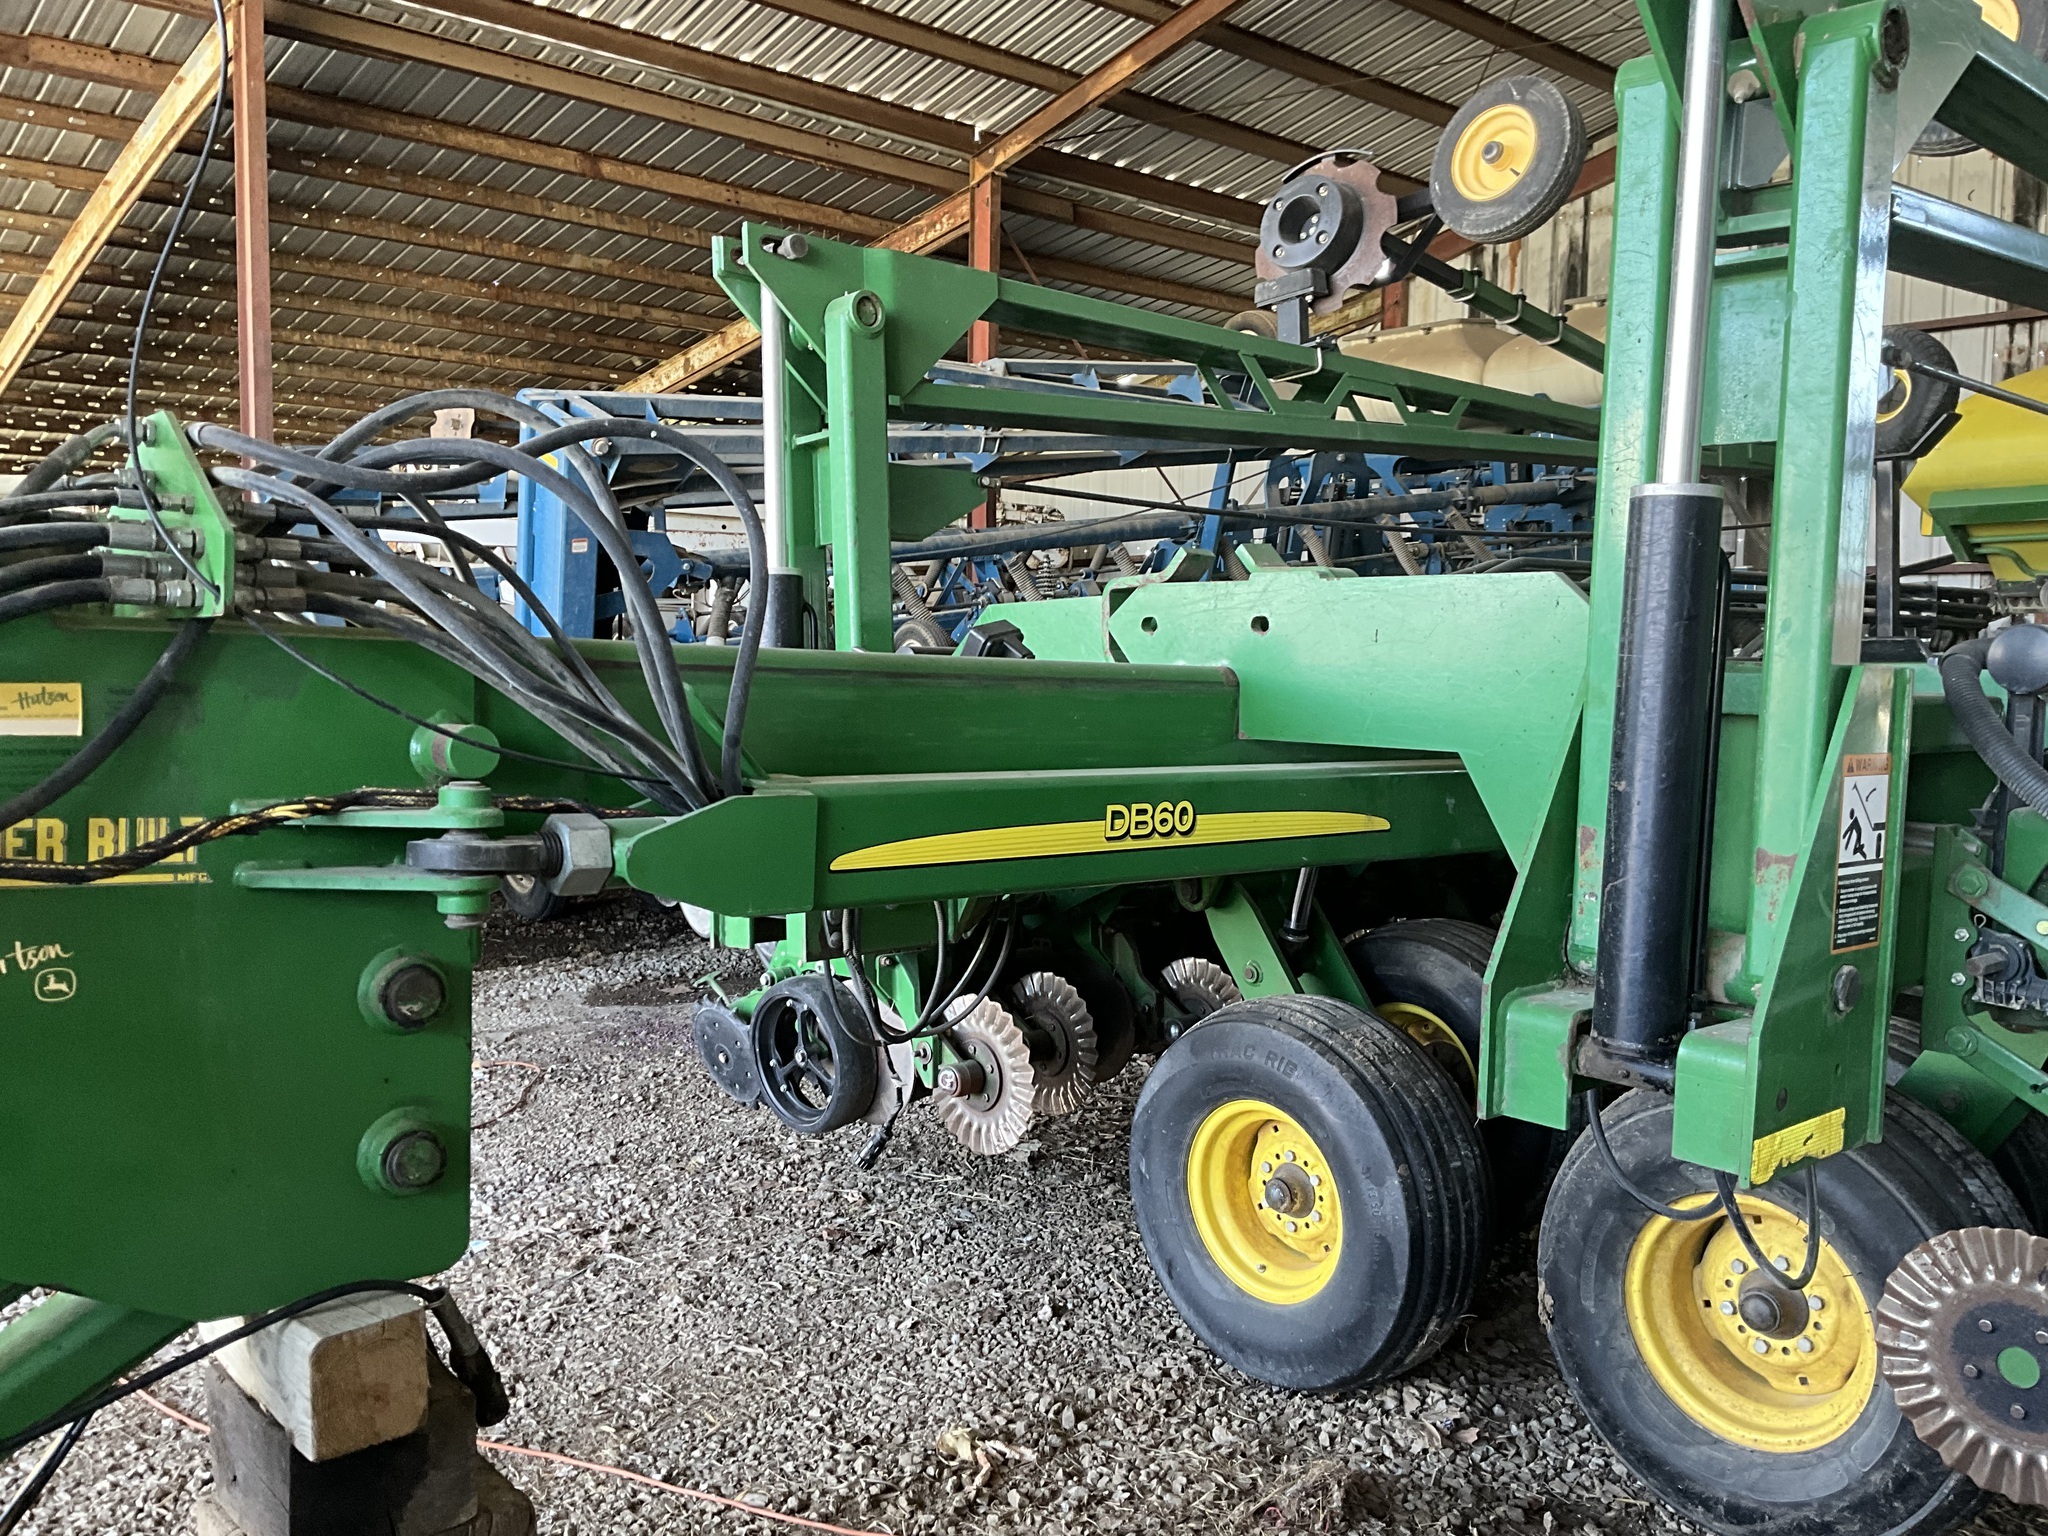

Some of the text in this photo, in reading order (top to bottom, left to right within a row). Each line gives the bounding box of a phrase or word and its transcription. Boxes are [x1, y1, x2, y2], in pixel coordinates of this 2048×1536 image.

[1856, 758, 1889, 771] WARG
[0, 818, 67, 864] ER
[1105, 800, 1195, 841] DB60
